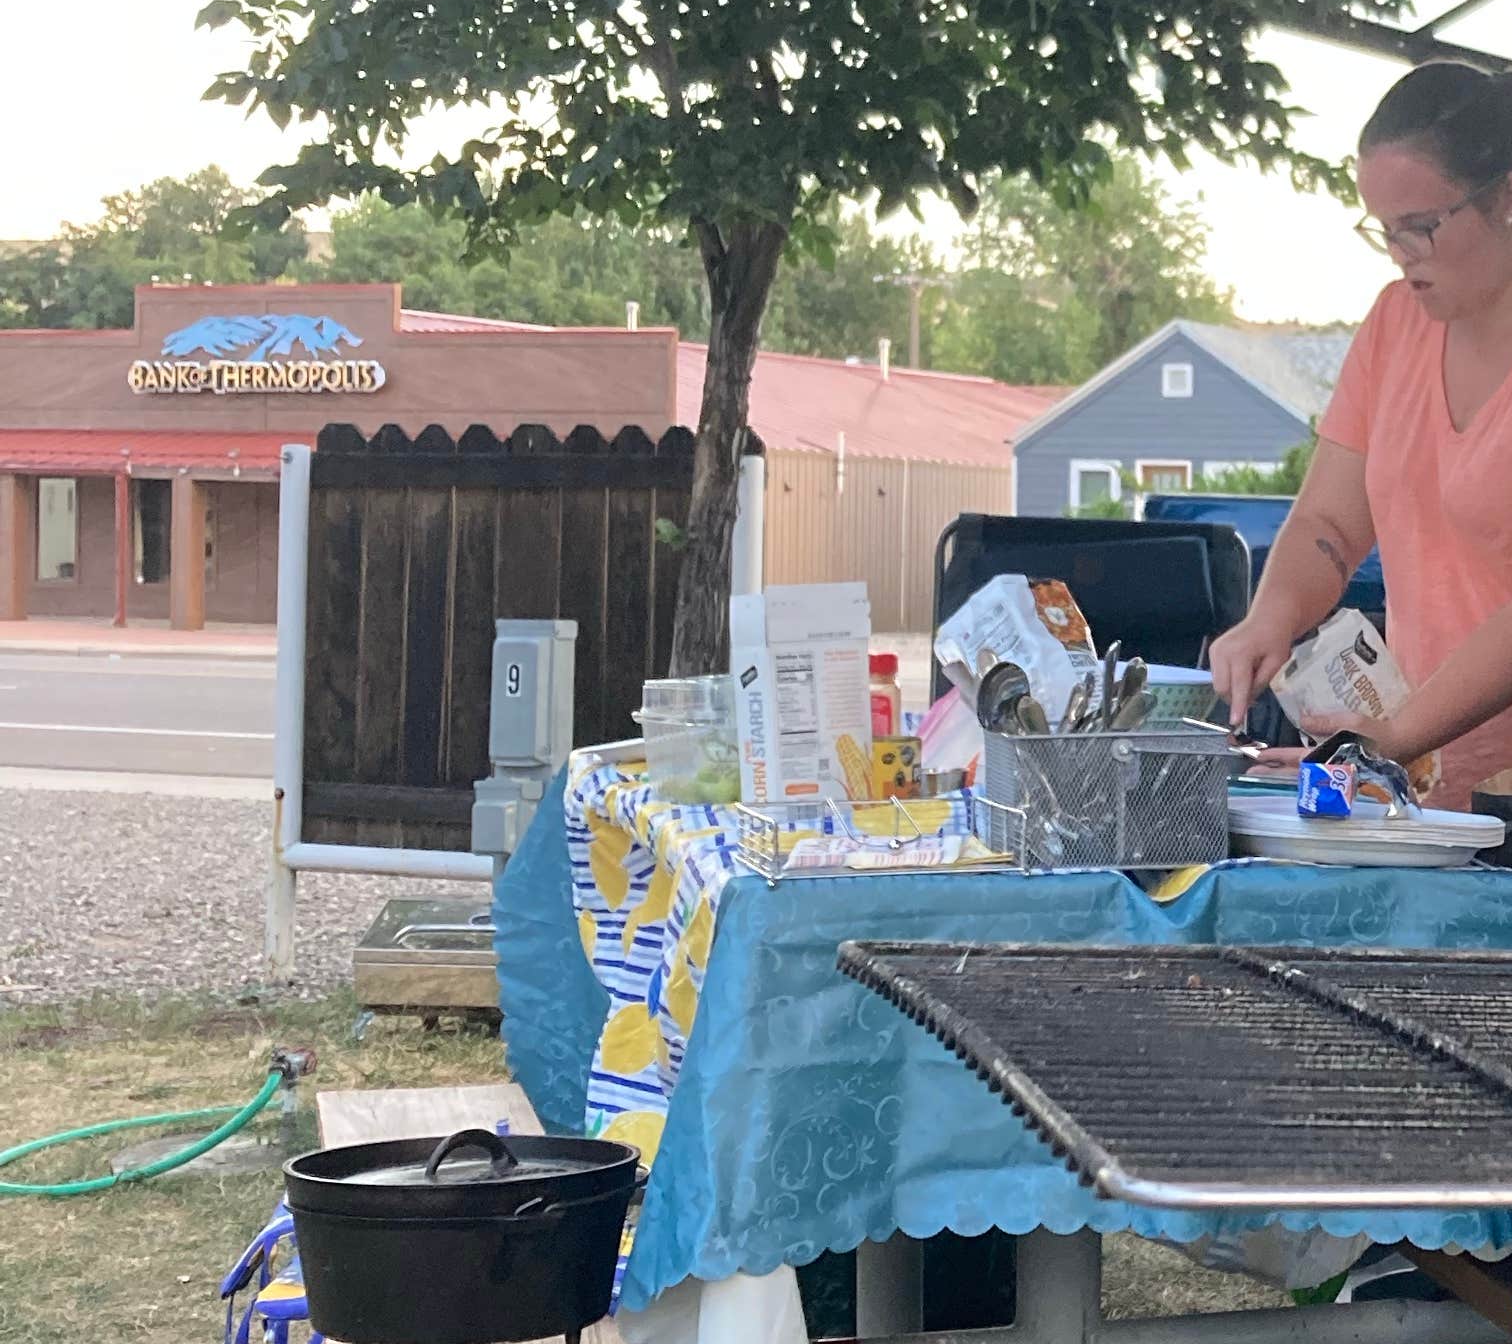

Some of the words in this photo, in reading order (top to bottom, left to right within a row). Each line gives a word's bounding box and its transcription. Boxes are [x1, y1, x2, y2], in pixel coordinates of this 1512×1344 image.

[129, 360, 190, 391] BANK
[208, 359, 379, 392] THERMOPOLIS
[508, 664, 520, 695] 9
[1324, 656, 1361, 712] SUGAR
[748, 691, 766, 758] STARCH
[1330, 769, 1348, 792] 30
